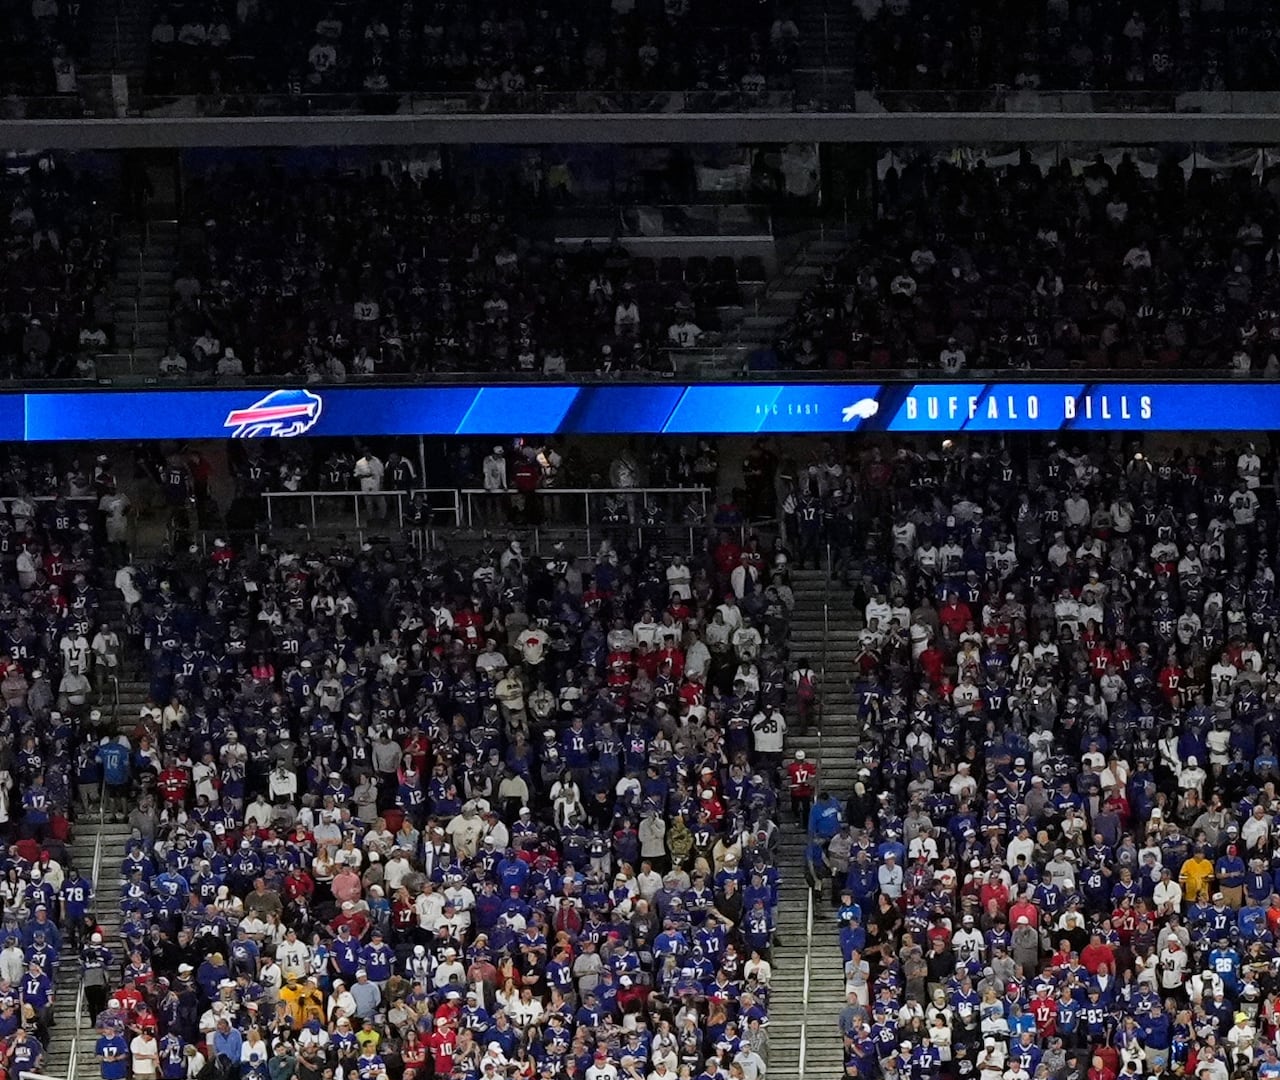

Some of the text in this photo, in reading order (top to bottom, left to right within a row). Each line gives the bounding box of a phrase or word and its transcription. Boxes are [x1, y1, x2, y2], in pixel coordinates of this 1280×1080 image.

[906, 396, 1153, 419] BUFFALO BILLS
[11, 646, 27, 659] 34
[283, 640, 298, 653] 20
[989, 696, 1001, 710] 17
[573, 737, 584, 750] 17
[352, 747, 365, 759] 14
[796, 769, 808, 783] 17
[409, 790, 423, 804] 12
[735, 786, 743, 799] 7
[32, 796, 45, 808] 17
[695, 832, 709, 844] 17
[177, 857, 189, 869] 17
[1088, 875, 1101, 888] 49
[66, 888, 83, 901] 78
[399, 910, 412, 922] 17
[751, 920, 767, 933] 34
[706, 938, 719, 951] 17
[345, 948, 354, 962] 4
[371, 953, 386, 965] 34
[27, 981, 40, 994] 17
[122, 997, 137, 1009] 17
[466, 1016, 480, 1028] 12
[1088, 1009, 1103, 1022] 83
[440, 1043, 452, 1055] 10
